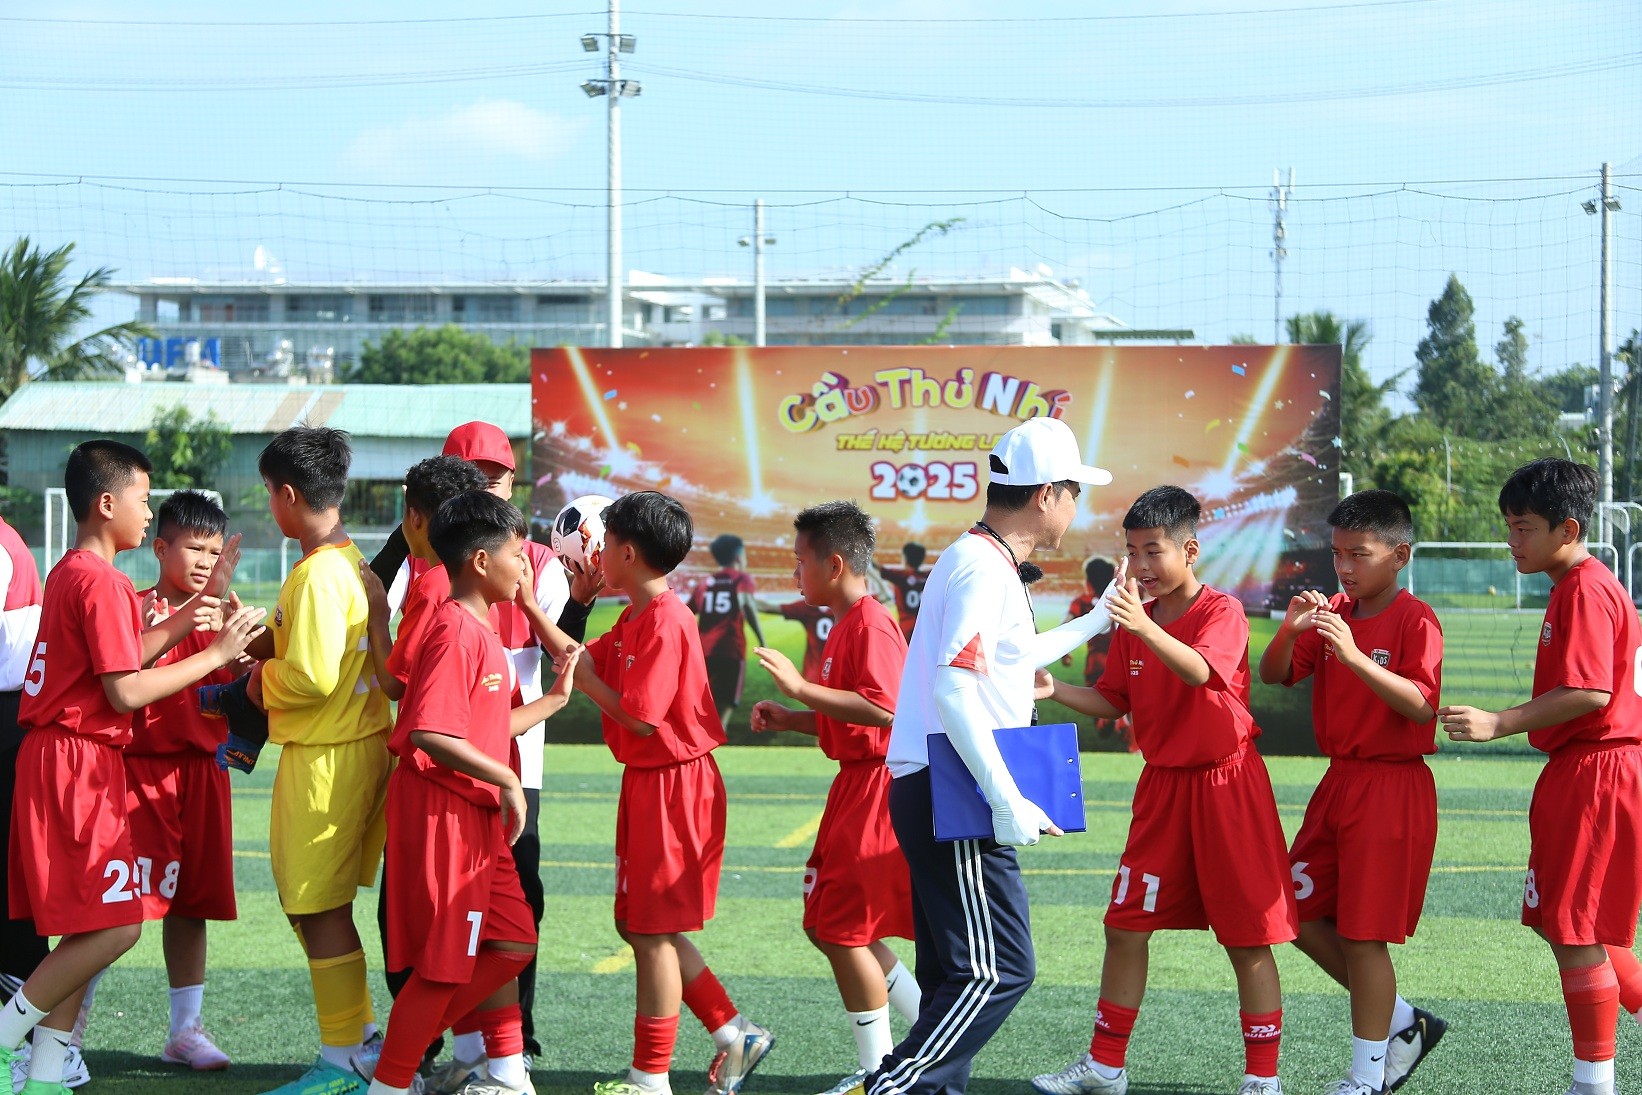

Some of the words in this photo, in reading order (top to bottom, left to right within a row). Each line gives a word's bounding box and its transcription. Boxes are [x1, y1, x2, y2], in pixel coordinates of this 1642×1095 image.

[777, 371, 877, 433] Cầu
[875, 367, 974, 409] Thủ
[836, 428, 878, 450] THẾ
[877, 429, 907, 453] HỆ
[870, 461, 980, 502] 2025
[704, 591, 732, 613] 15
[24, 641, 47, 697] 5
[1113, 864, 1160, 912] 11
[1291, 861, 1314, 900] 6
[467, 910, 483, 956] 1
